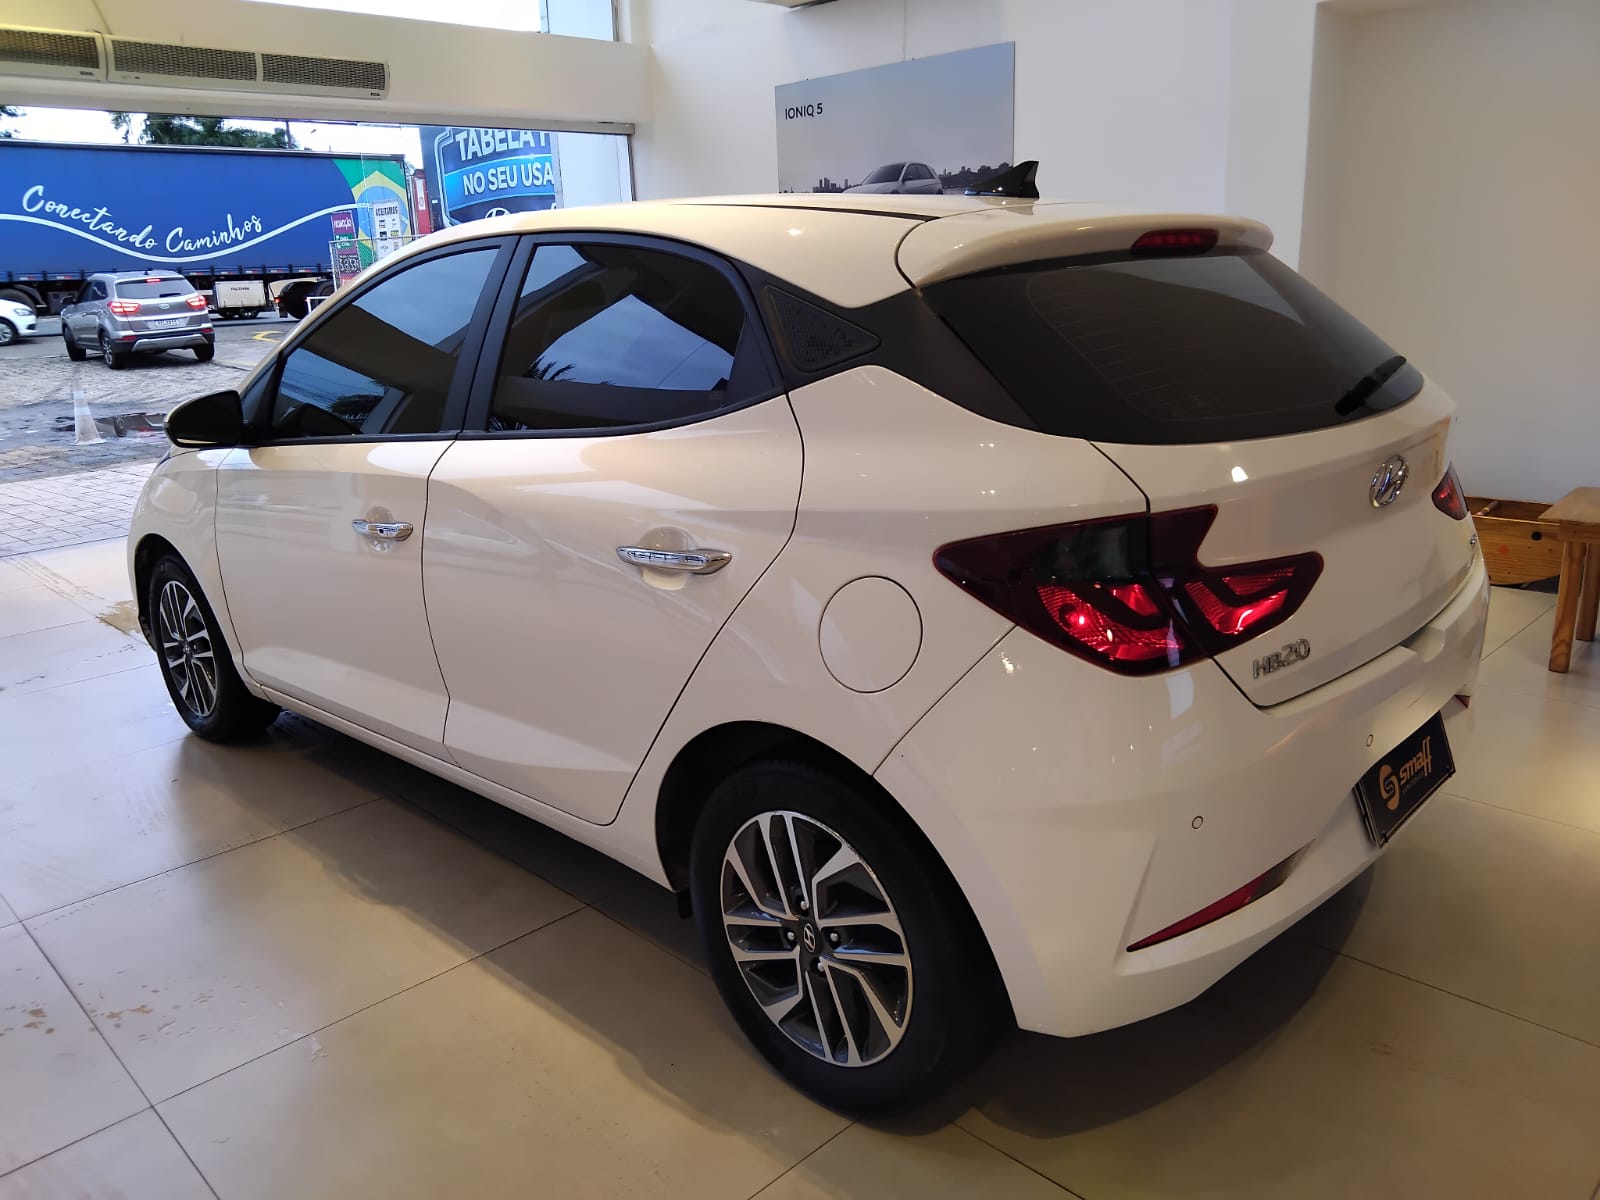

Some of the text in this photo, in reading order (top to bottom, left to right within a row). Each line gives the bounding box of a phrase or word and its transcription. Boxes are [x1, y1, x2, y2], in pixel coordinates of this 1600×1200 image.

[785, 102, 823, 120] IONIQ 5
[455, 128, 535, 161] TABELA
[463, 171, 485, 196] NO
[487, 164, 518, 191] SEU
[22, 185, 262, 253] Conectando Caminhos
[1253, 638, 1311, 680] HB20
